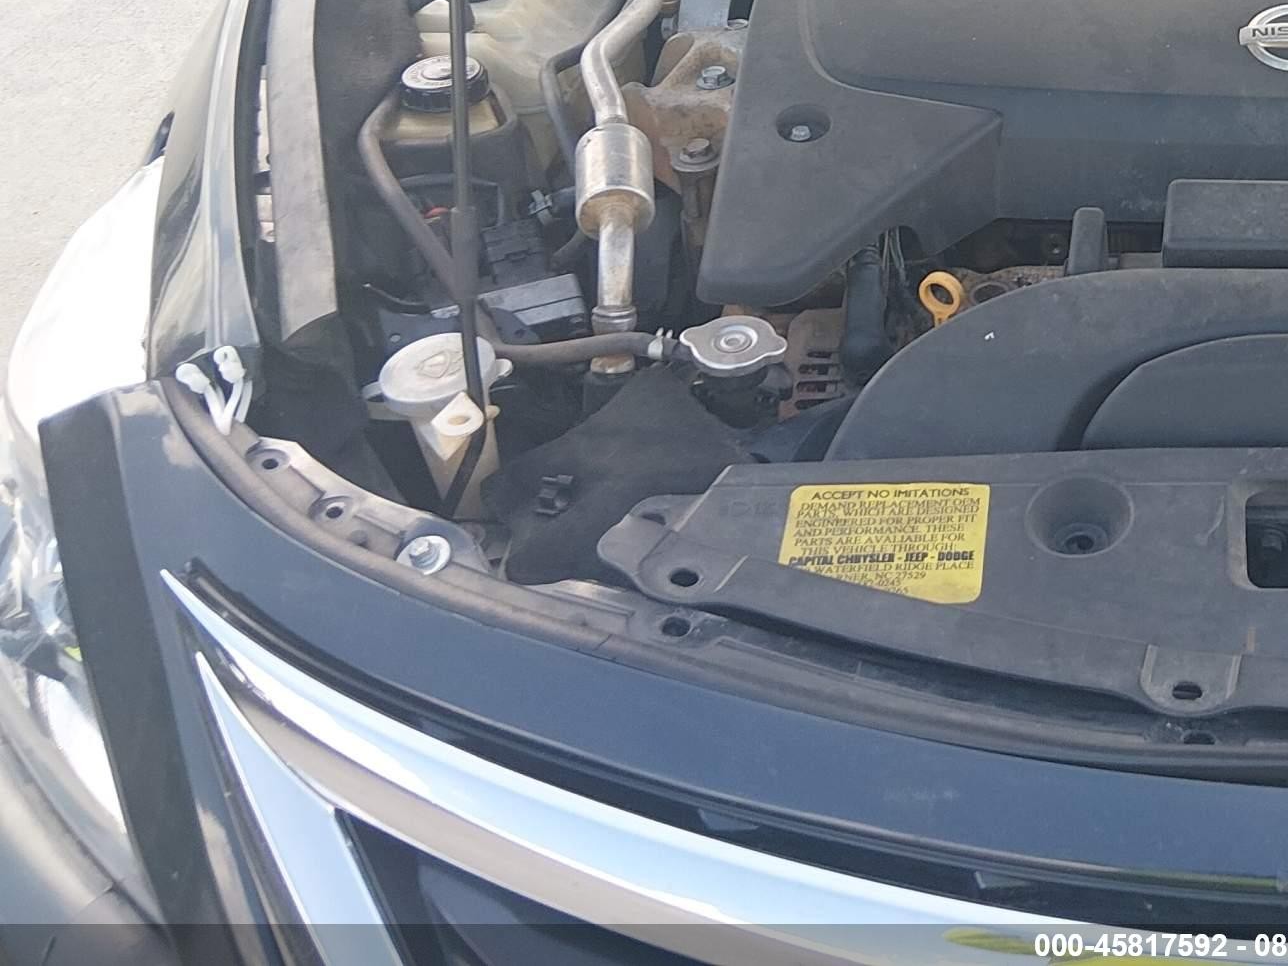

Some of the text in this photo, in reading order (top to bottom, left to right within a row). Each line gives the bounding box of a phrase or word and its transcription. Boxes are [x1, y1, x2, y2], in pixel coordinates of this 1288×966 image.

[811, 487, 970, 500] ACCEPT NO IMITATIONS
[801, 497, 981, 511] DEMAND REPLACEMENT OEM
[843, 507, 886, 516] WHICH
[889, 506, 915, 515] ARE
[917, 505, 980, 515] DESIGNED
[795, 514, 977, 528] ENGINEERED FOR PROPER FIT
[793, 528, 821, 537] AND
[927, 523, 965, 533] THESE
[794, 537, 832, 546] PARTS
[835, 536, 861, 545] ARE
[941, 533, 966, 542] FOR
[801, 547, 830, 556] THIS
[834, 545, 886, 555] VEHICLE
[837, 553, 895, 564] CHRYSLER
[904, 552, 929, 562] JEEP
[938, 550, 975, 561] DODGE
[895, 562, 933, 571] RIDGE
[935, 561, 975, 570] PLACE
[874, 571, 891, 580] NC
[894, 570, 927, 580] 27529
